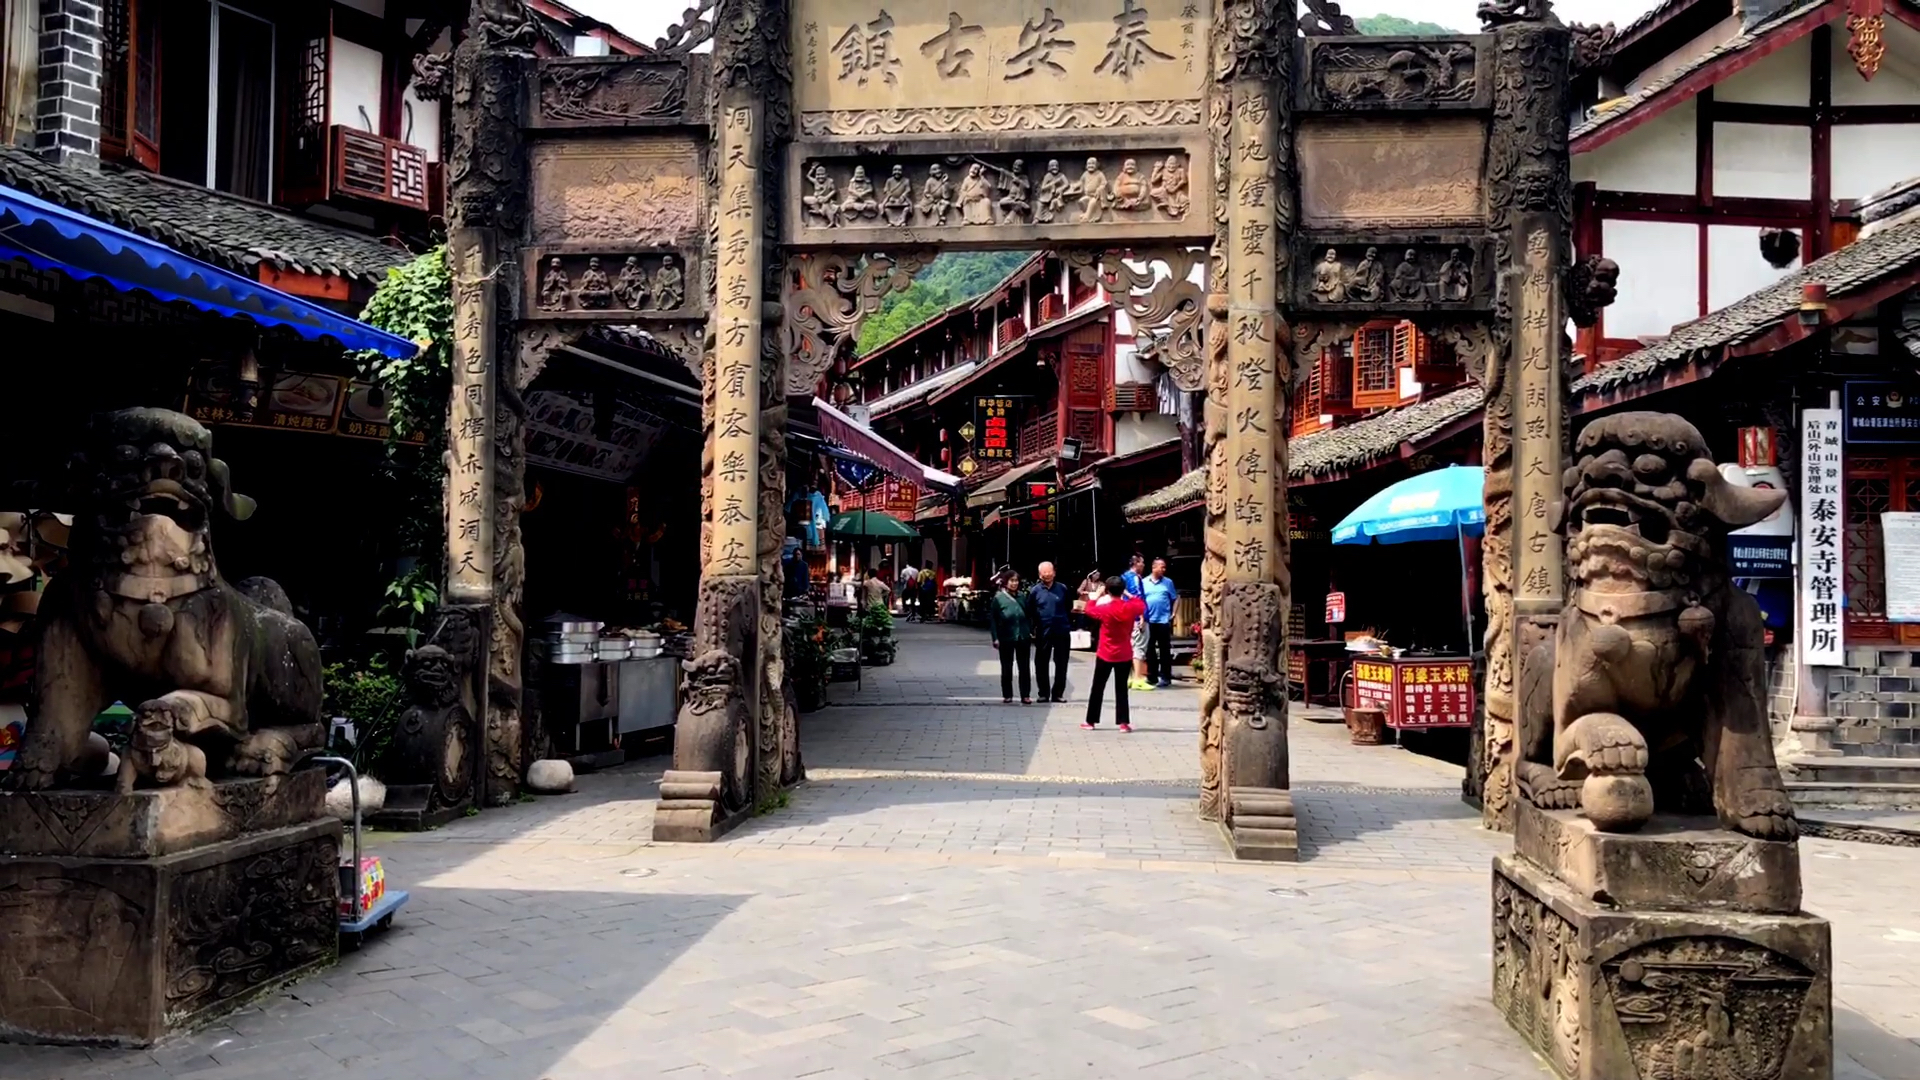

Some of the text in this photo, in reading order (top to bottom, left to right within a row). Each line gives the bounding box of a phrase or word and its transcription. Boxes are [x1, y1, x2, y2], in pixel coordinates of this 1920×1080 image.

[1856, 395, 1881, 406] 公安
[1825, 421, 1838, 494] 青城山景区
[1809, 498, 1838, 653] 泰安寺管理所
[1402, 666, 1469, 683] 汤婆玉米饼
